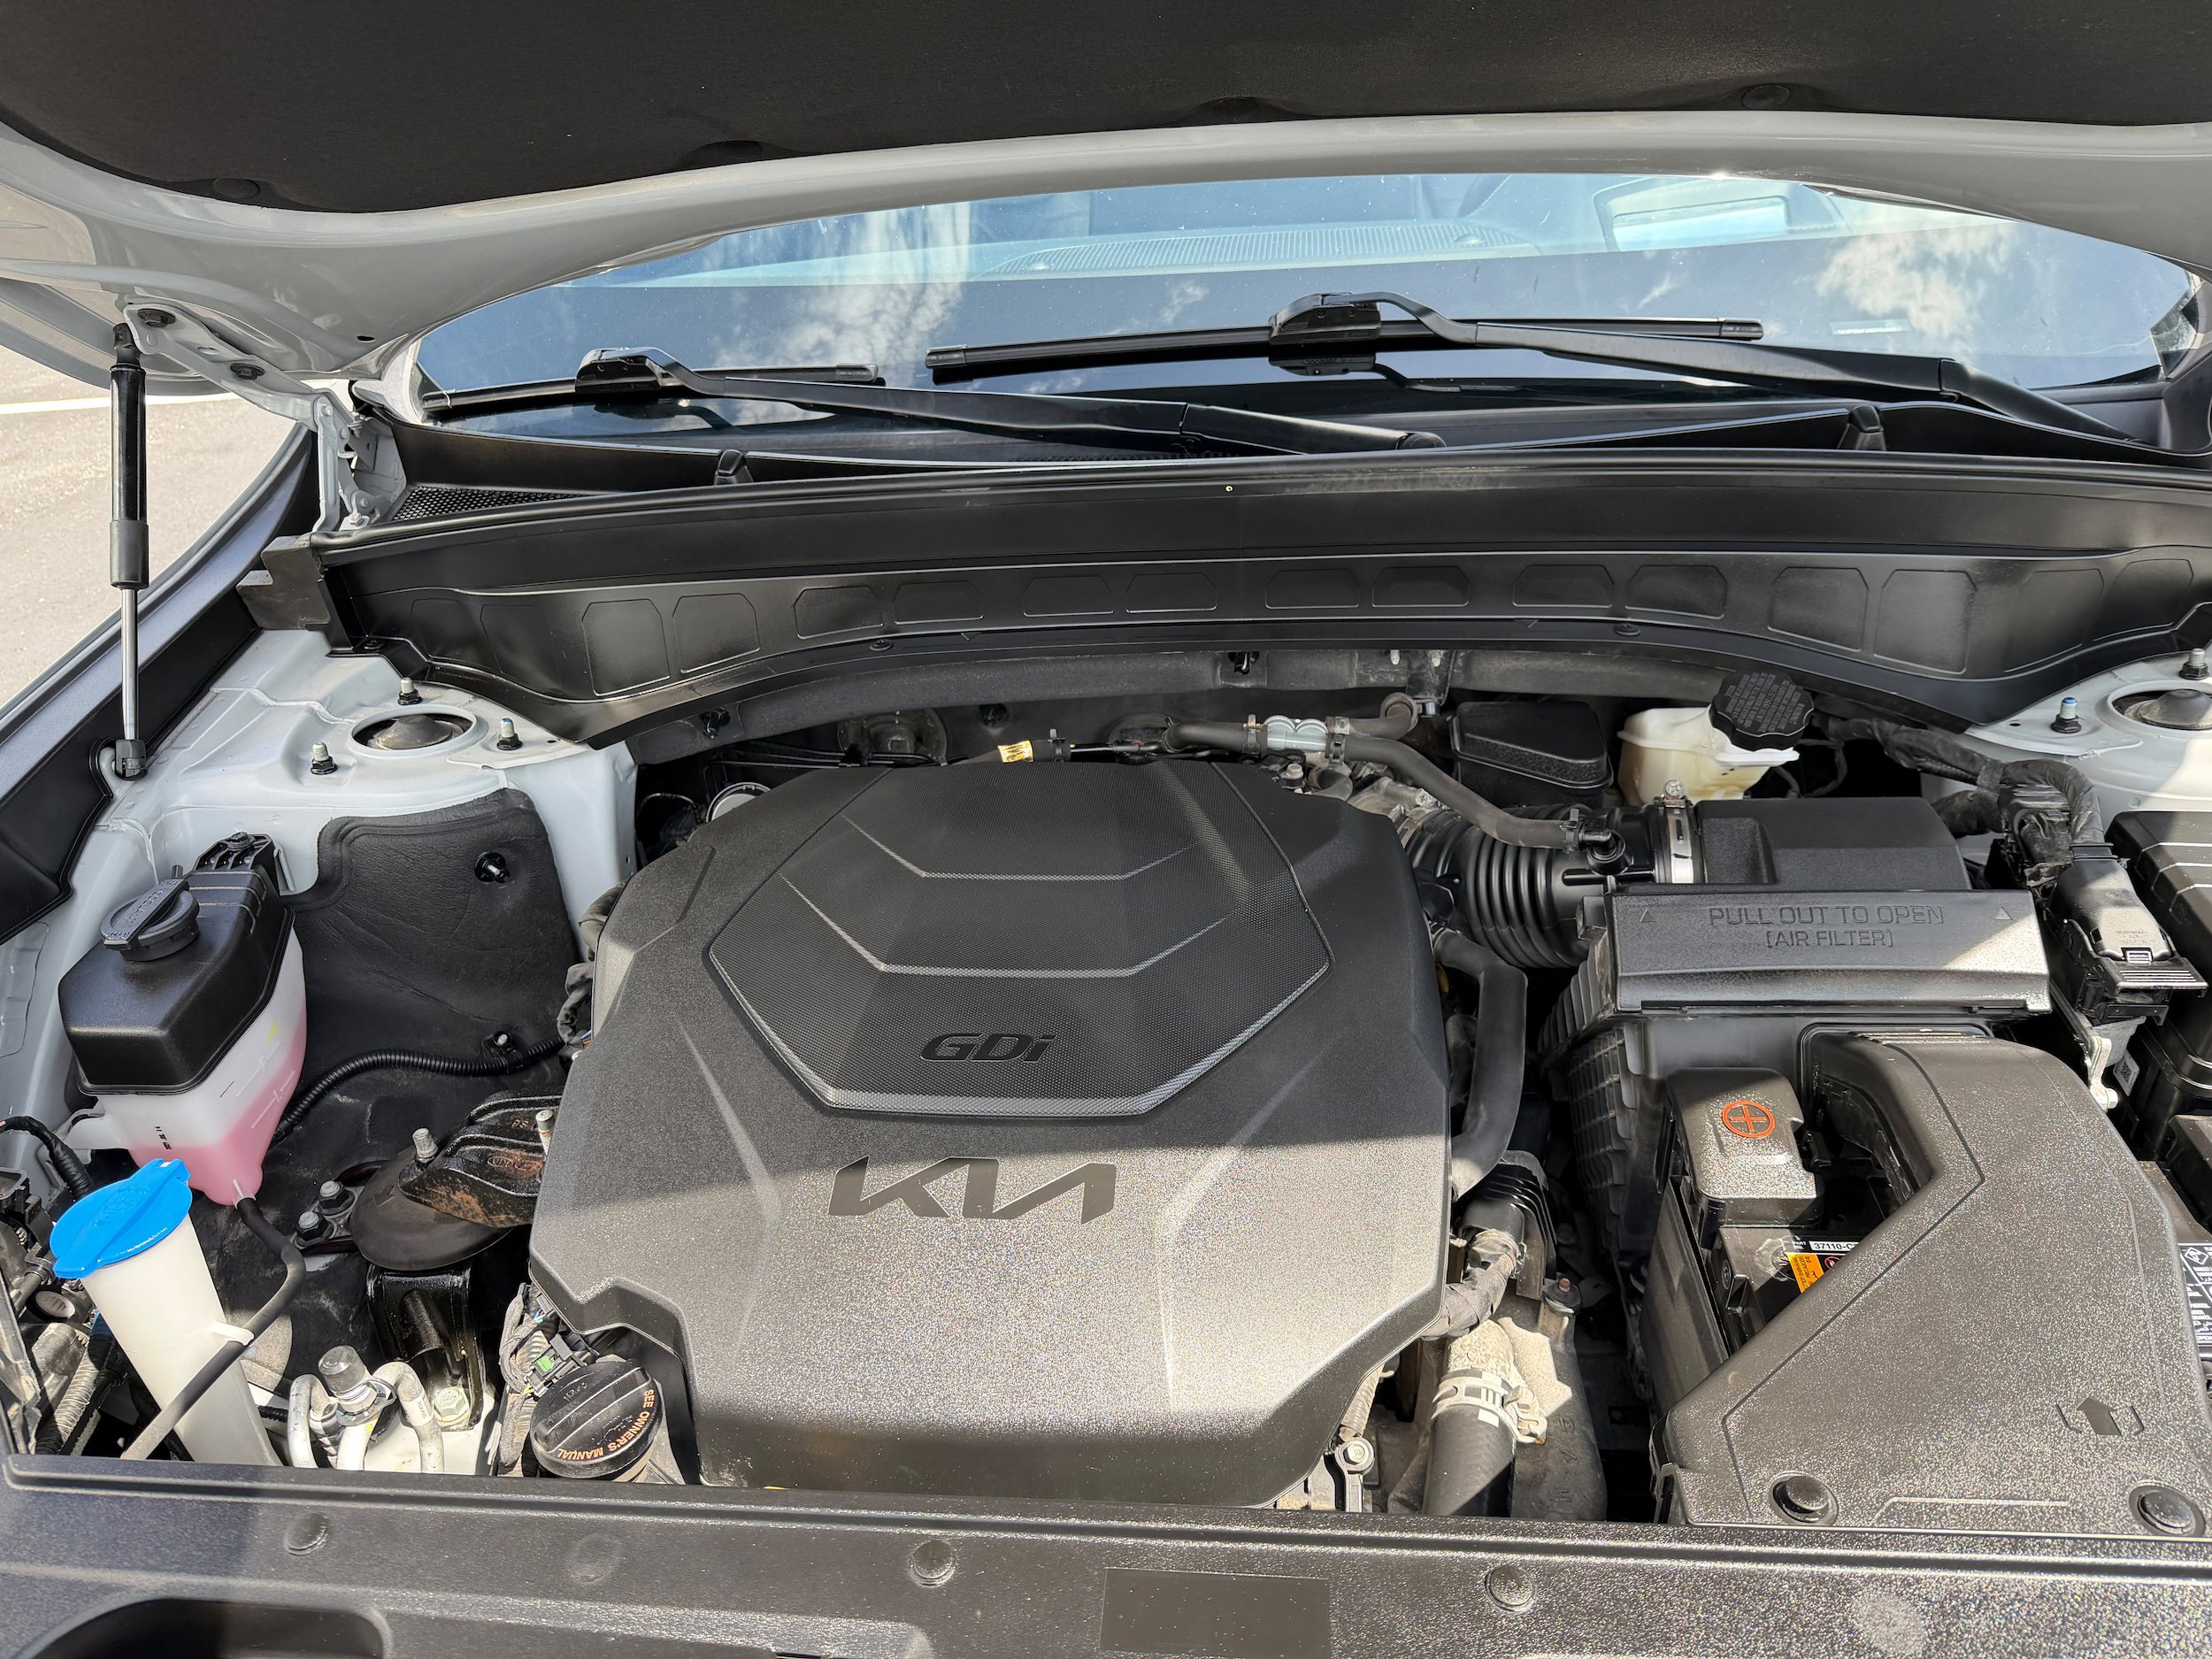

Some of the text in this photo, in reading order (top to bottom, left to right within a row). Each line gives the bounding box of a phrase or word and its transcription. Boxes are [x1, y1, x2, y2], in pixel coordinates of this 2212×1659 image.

[1709, 905, 1945, 926] PULL OUT TO OPEN
[921, 1032, 1057, 1063] GDi
[827, 1155, 1118, 1225] KIA
[557, 1389, 655, 1460] SEE OWNER'S MANUAL
